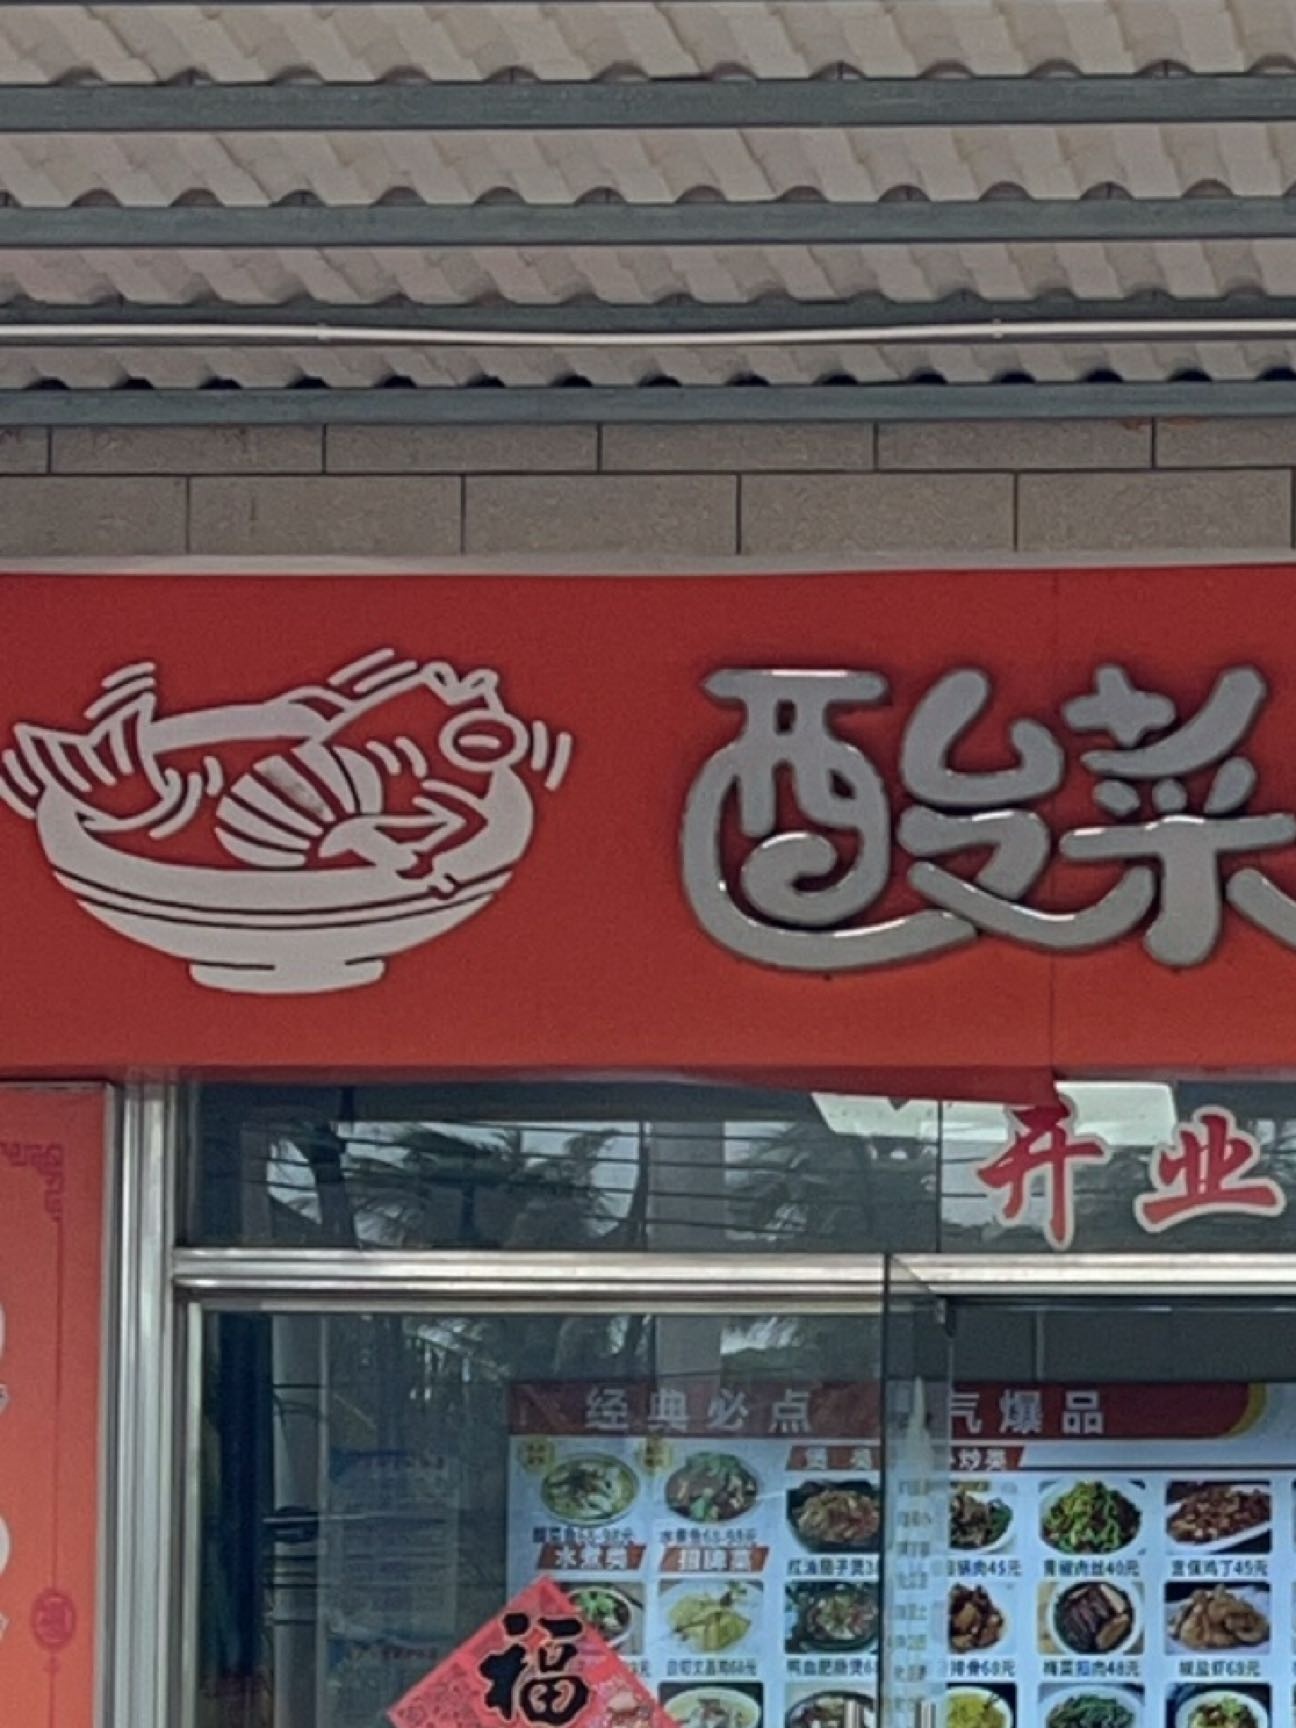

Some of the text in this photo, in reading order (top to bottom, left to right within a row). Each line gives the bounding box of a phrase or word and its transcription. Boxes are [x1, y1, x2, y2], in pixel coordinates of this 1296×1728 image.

[584, 1388, 811, 1433] 经典必点
[479, 1611, 591, 1728] 福
